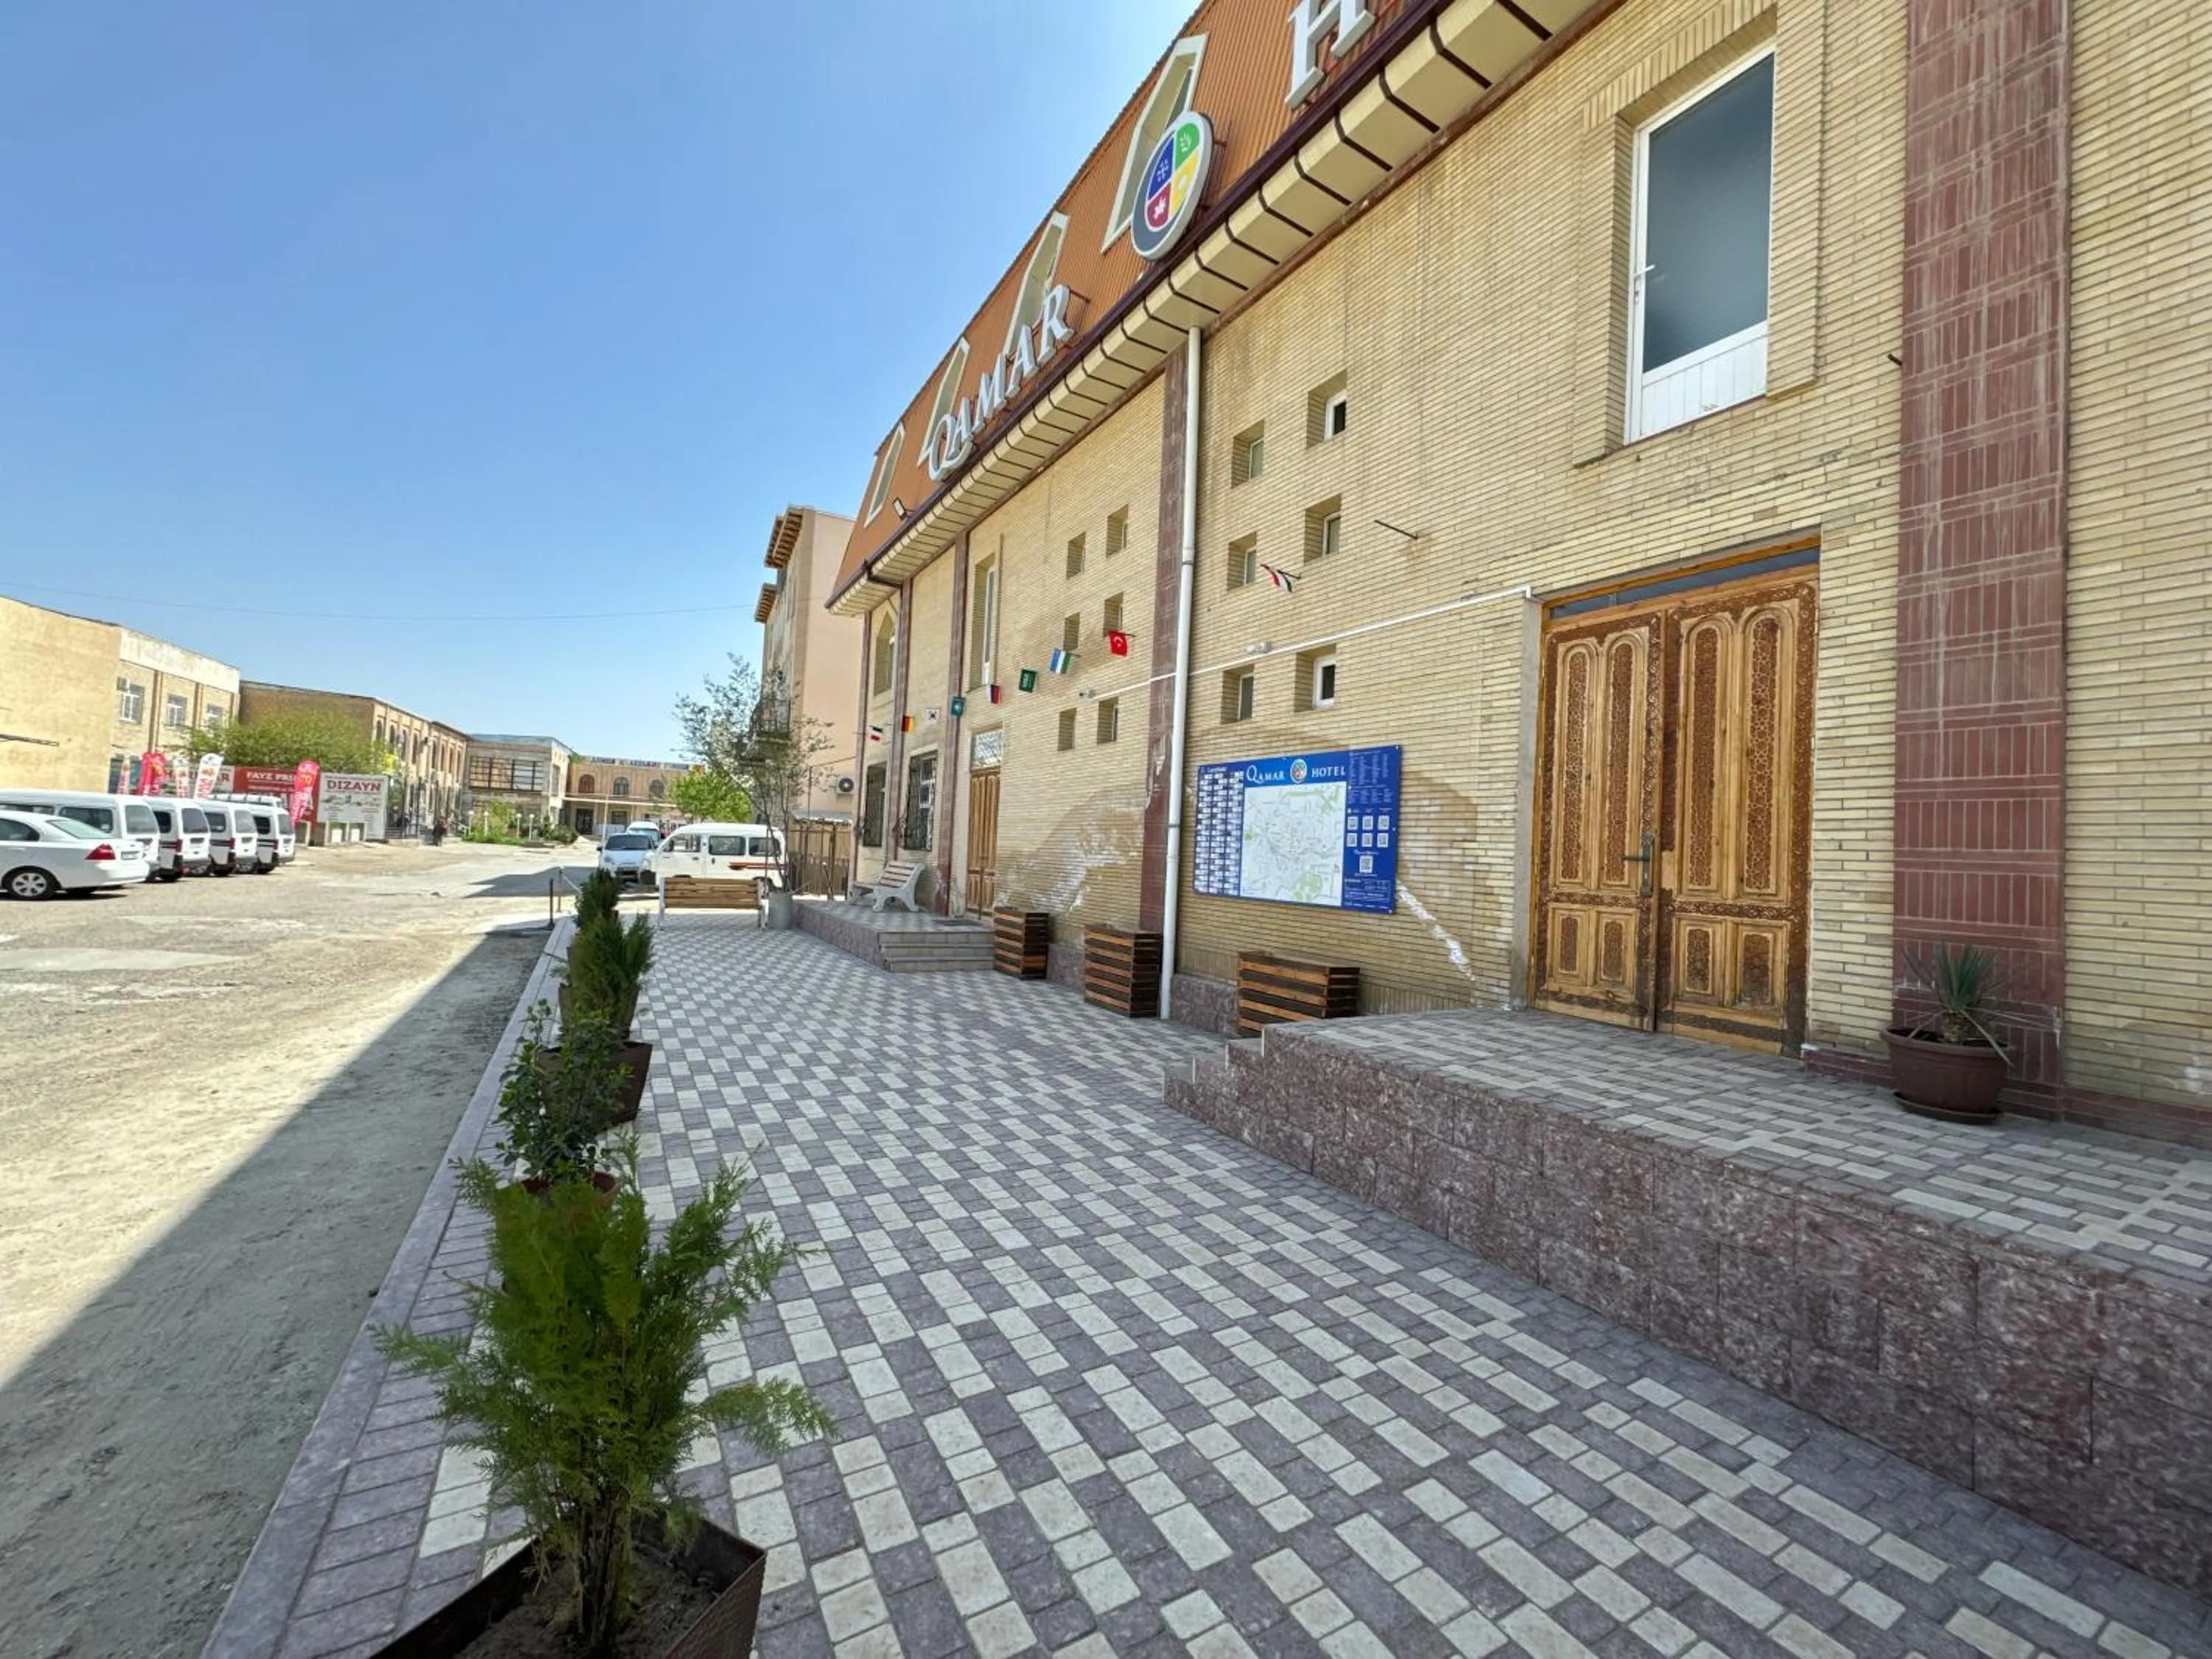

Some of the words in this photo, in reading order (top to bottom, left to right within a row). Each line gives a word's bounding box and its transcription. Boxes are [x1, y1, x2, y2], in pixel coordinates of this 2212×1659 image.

[928, 284, 1074, 483] QAMAR
[246, 771, 273, 779] FAYZ
[1246, 765, 1284, 784] QAMAR
[1312, 766, 1346, 778] HOTEL
[327, 779, 381, 792] DIZAYN
